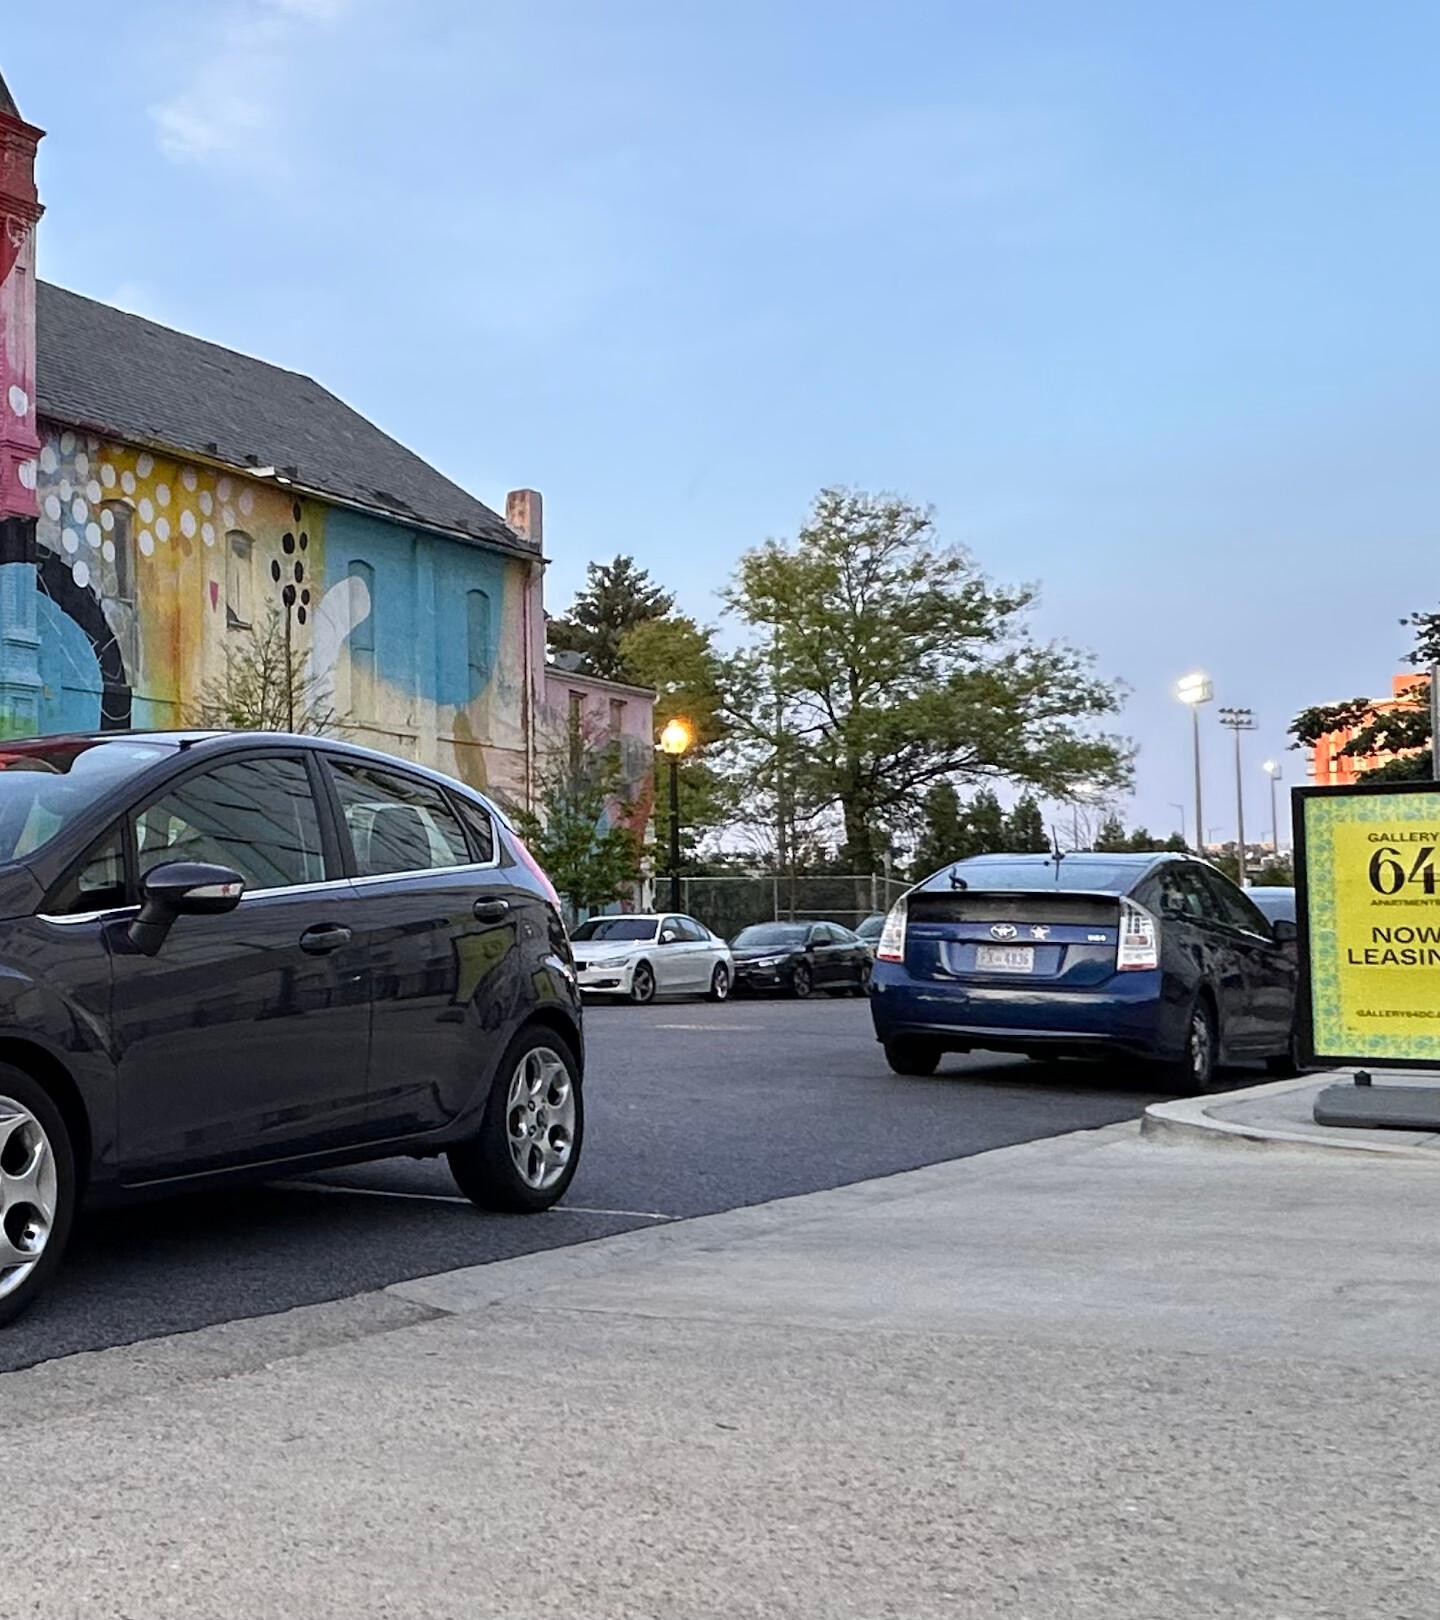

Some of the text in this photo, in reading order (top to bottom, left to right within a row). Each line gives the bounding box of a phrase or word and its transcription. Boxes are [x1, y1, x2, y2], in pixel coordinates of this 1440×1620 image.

[1367, 832, 1440, 843] GALLERY
[1369, 847, 1440, 895] 64
[1372, 926, 1440, 944] NOW
